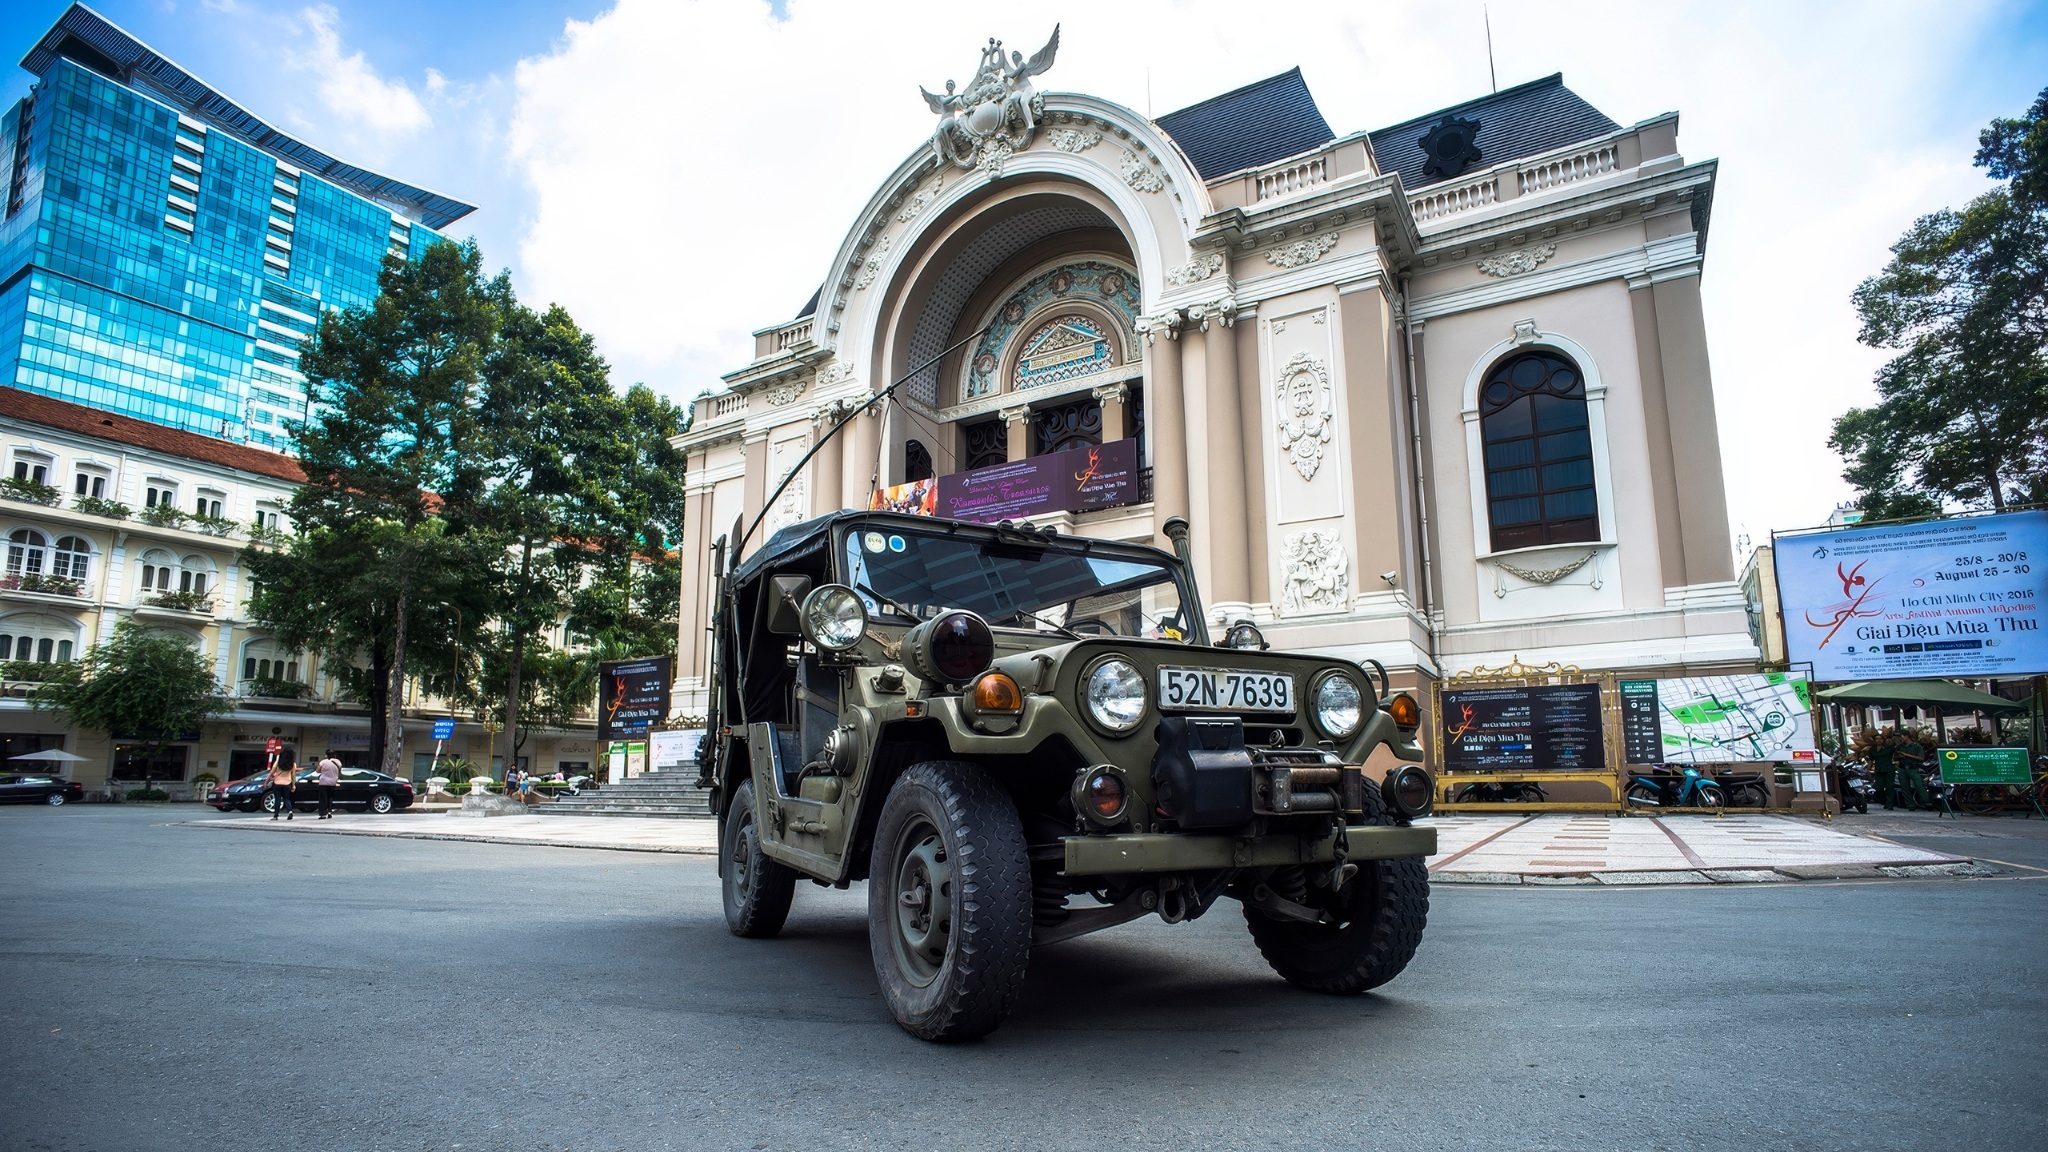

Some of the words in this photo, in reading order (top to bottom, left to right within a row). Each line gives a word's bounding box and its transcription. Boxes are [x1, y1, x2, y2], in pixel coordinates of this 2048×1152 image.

[1955, 556, 1983, 566] 25/8
[1997, 551, 2028, 563] 30/8
[1934, 569, 1980, 581] August
[1983, 567, 1999, 577] 25
[2014, 564, 2030, 574] 30
[1901, 598, 1919, 607] Ho
[1922, 595, 1942, 606] Chi
[1945, 593, 1976, 604] Minh
[1979, 592, 2004, 602] City
[1856, 625, 1891, 641] Giai
[1895, 623, 1941, 639] Điệu
[1994, 617, 2039, 632] Thu
